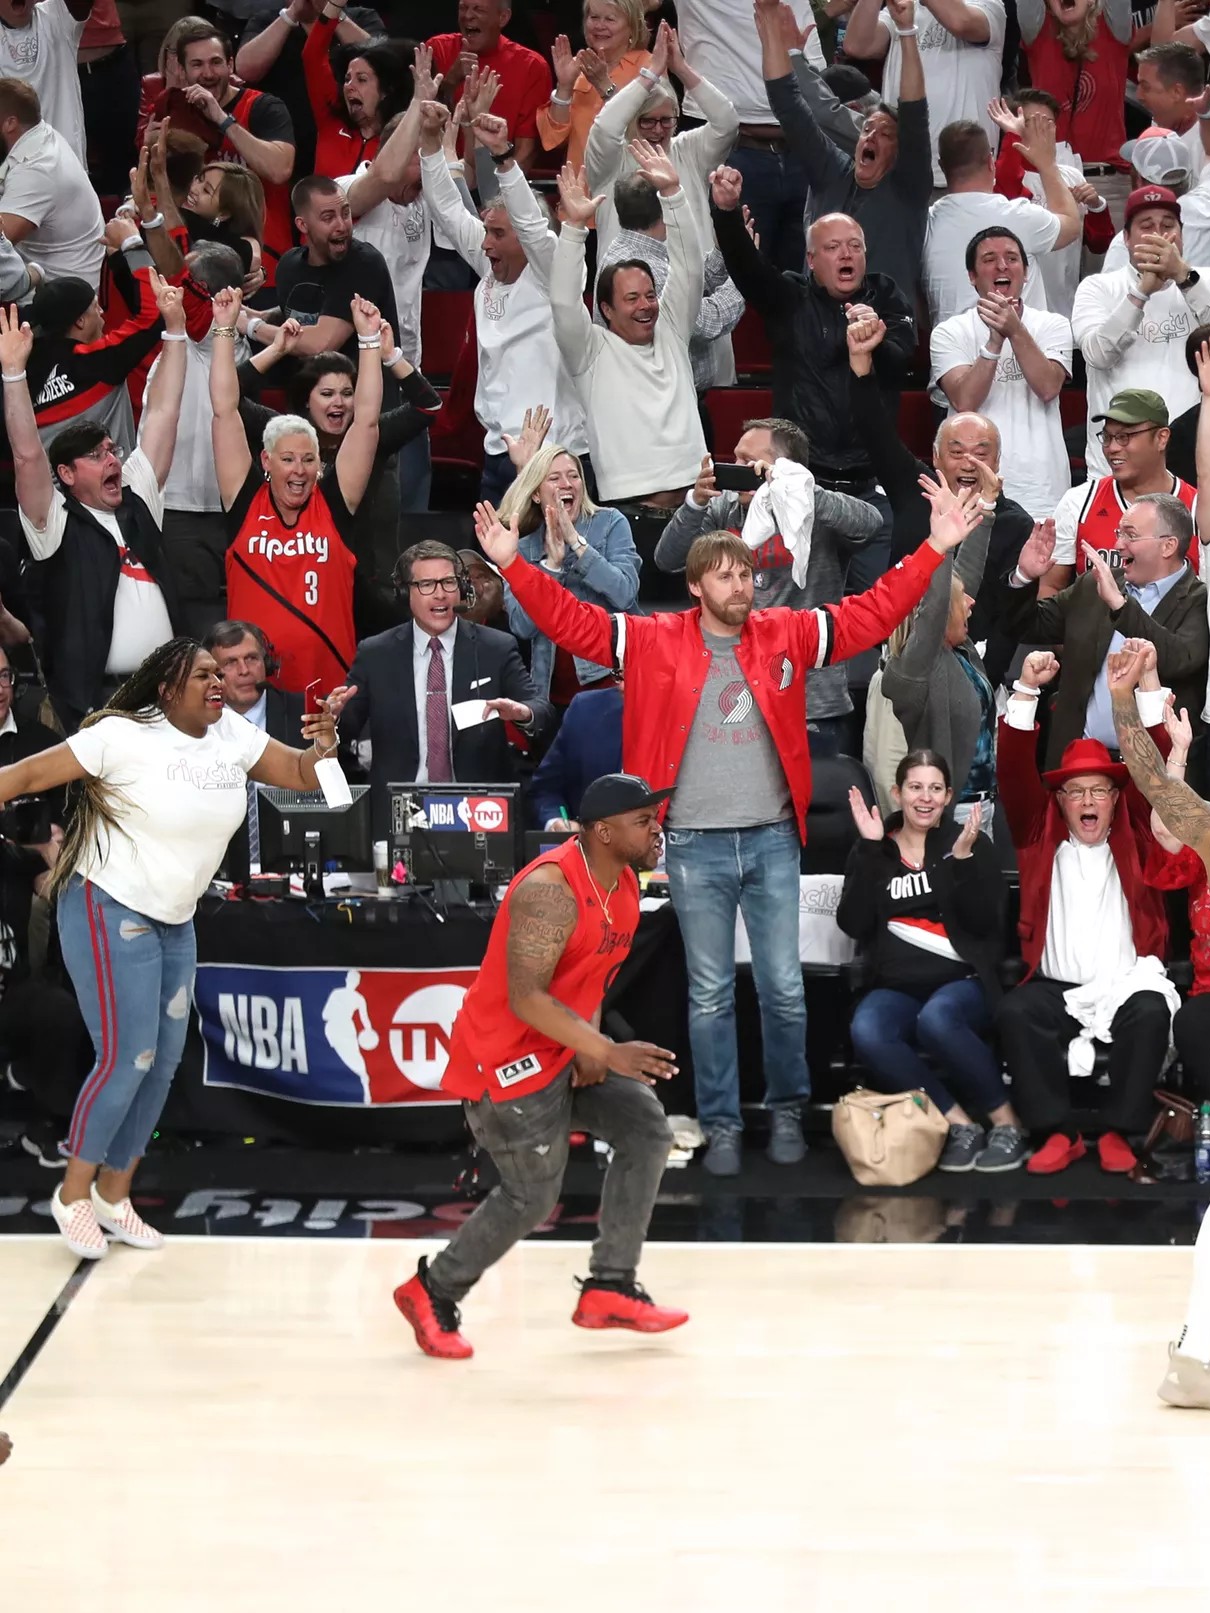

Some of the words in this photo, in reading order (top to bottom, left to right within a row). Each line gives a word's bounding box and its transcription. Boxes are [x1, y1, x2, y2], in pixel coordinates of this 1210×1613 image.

[248, 532, 329, 563] ripcity
[305, 570, 319, 606] 3
[429, 803, 455, 825] NBA
[475, 810, 504, 821] TNT
[218, 993, 309, 1075] NBA
